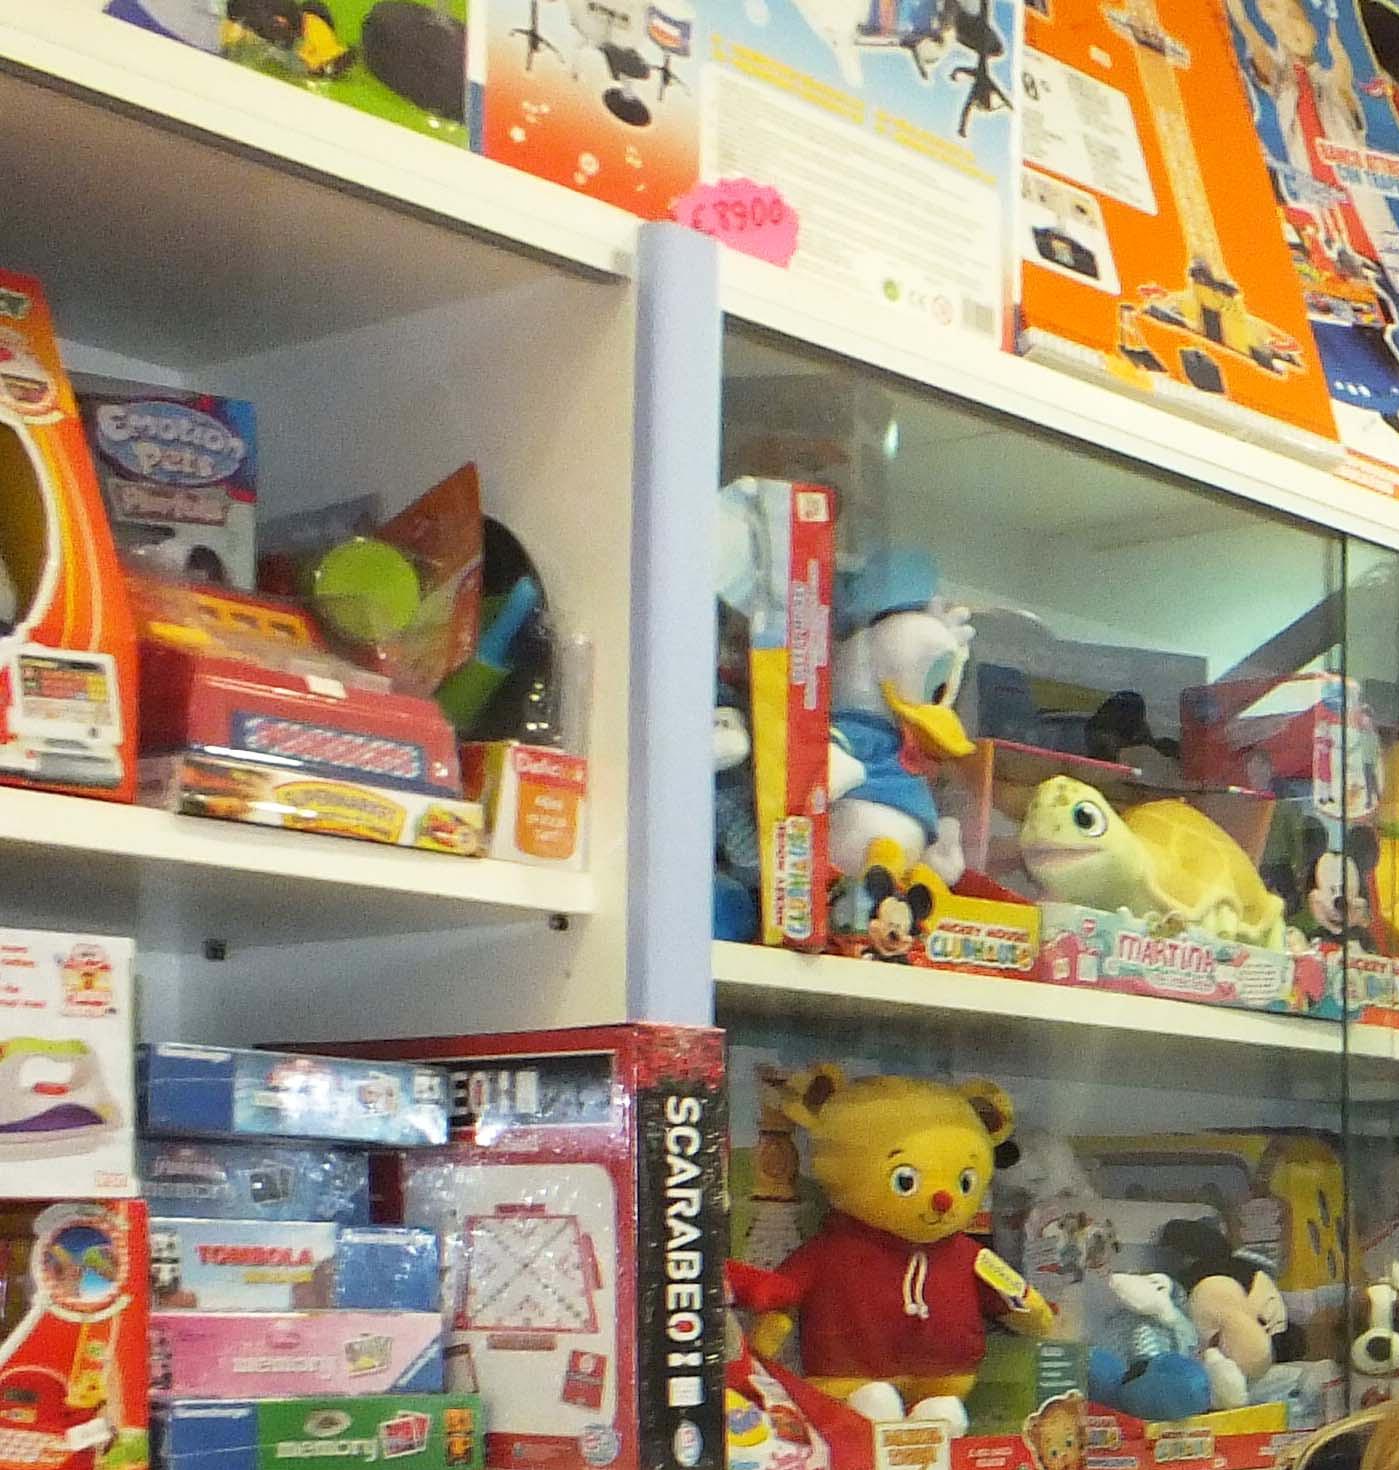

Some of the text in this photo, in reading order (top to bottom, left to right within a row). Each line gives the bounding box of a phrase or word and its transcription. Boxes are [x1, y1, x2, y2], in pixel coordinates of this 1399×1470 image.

[665, 1095, 702, 1346] SCARABEO
[194, 1244, 313, 1265] TOMBOLA
[277, 1440, 378, 1462] memory
